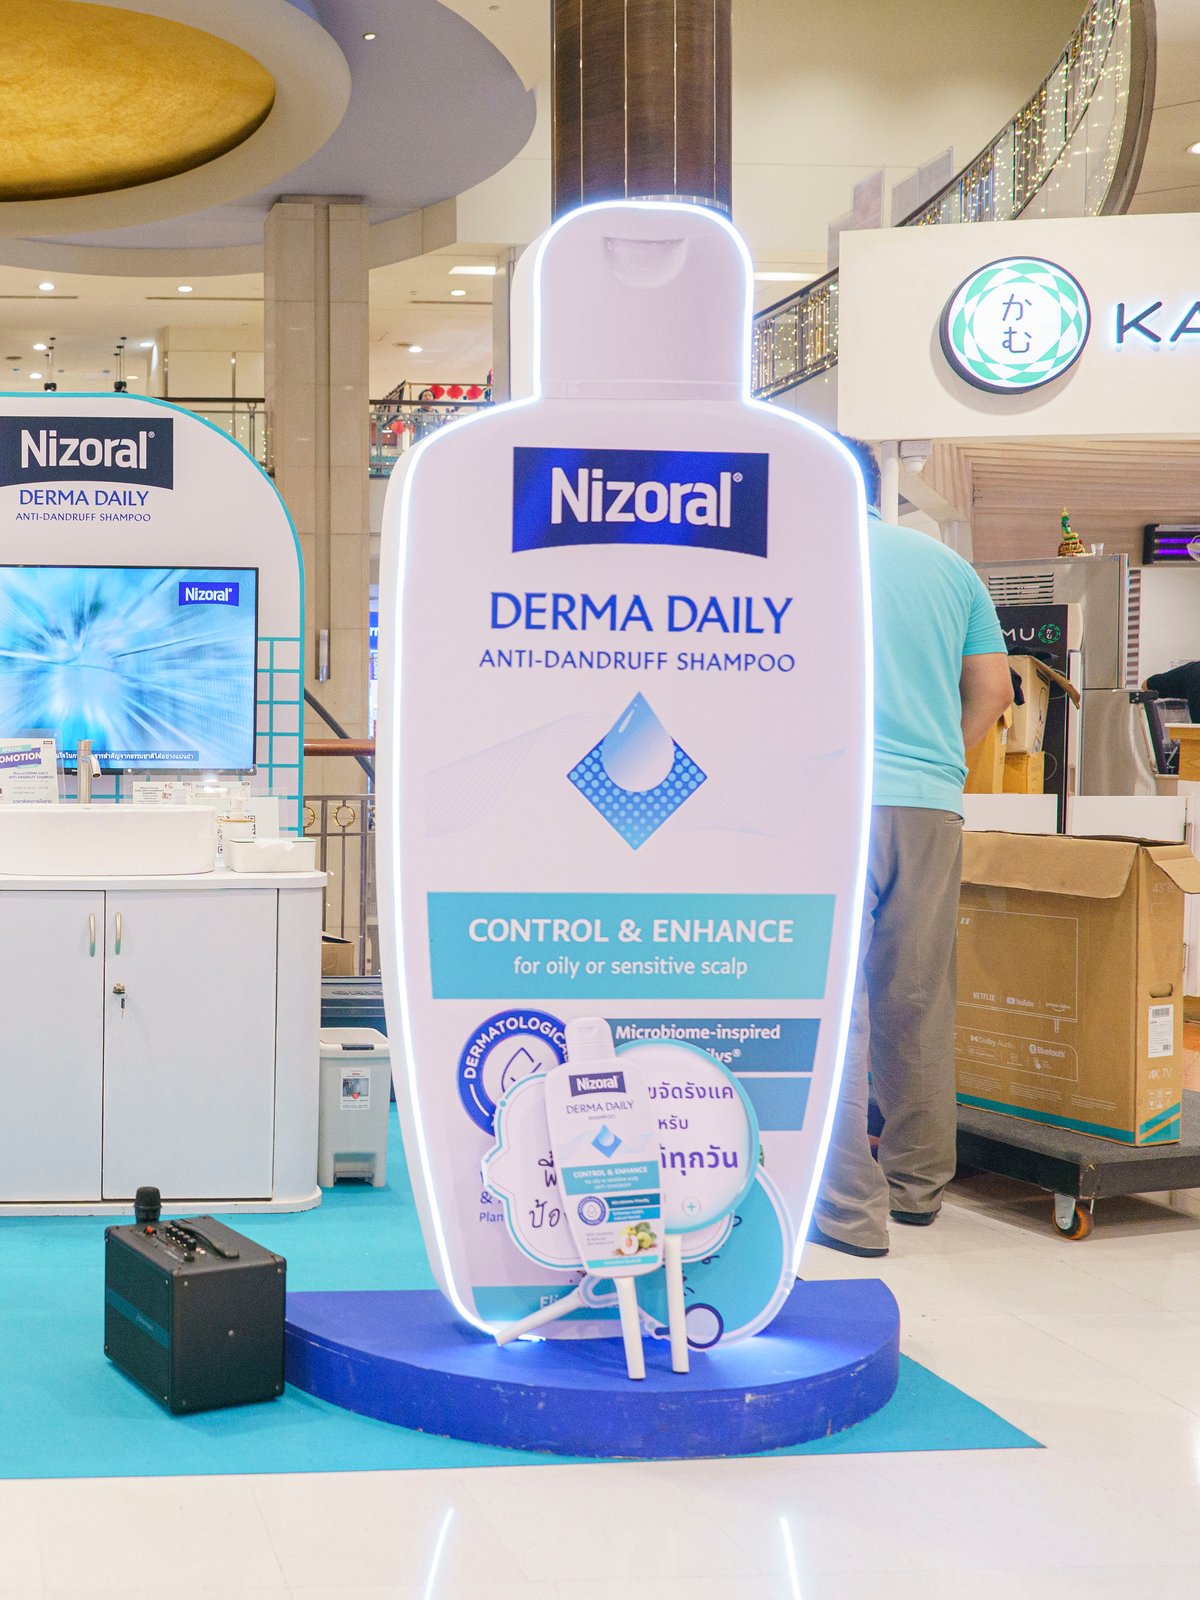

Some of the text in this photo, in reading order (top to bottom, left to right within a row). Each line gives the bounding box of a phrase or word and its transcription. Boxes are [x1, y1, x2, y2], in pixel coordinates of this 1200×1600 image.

[1002, 293, 1032, 353] かむ
[19, 489, 150, 506] DERMA DAILY
[15, 512, 151, 522] ANTI-DANDRUFF SHAMPOO
[490, 591, 794, 635] DERMA DAILY
[479, 649, 796, 672] ANTI-DANDRUFF SHAMPOO
[468, 917, 794, 944] CONTROL & ENHANCE
[513, 956, 748, 979] for oily or sensitive scalp
[973, 992, 995, 1001] NETFLIX
[615, 1024, 781, 1043] Microbiome-inspired
[978, 1036, 996, 1047] Dolby
[566, 1100, 634, 1114] DERMA DAILY
[657, 1114, 689, 1130] หรับ
[528, 1198, 566, 1229] ป้อ
